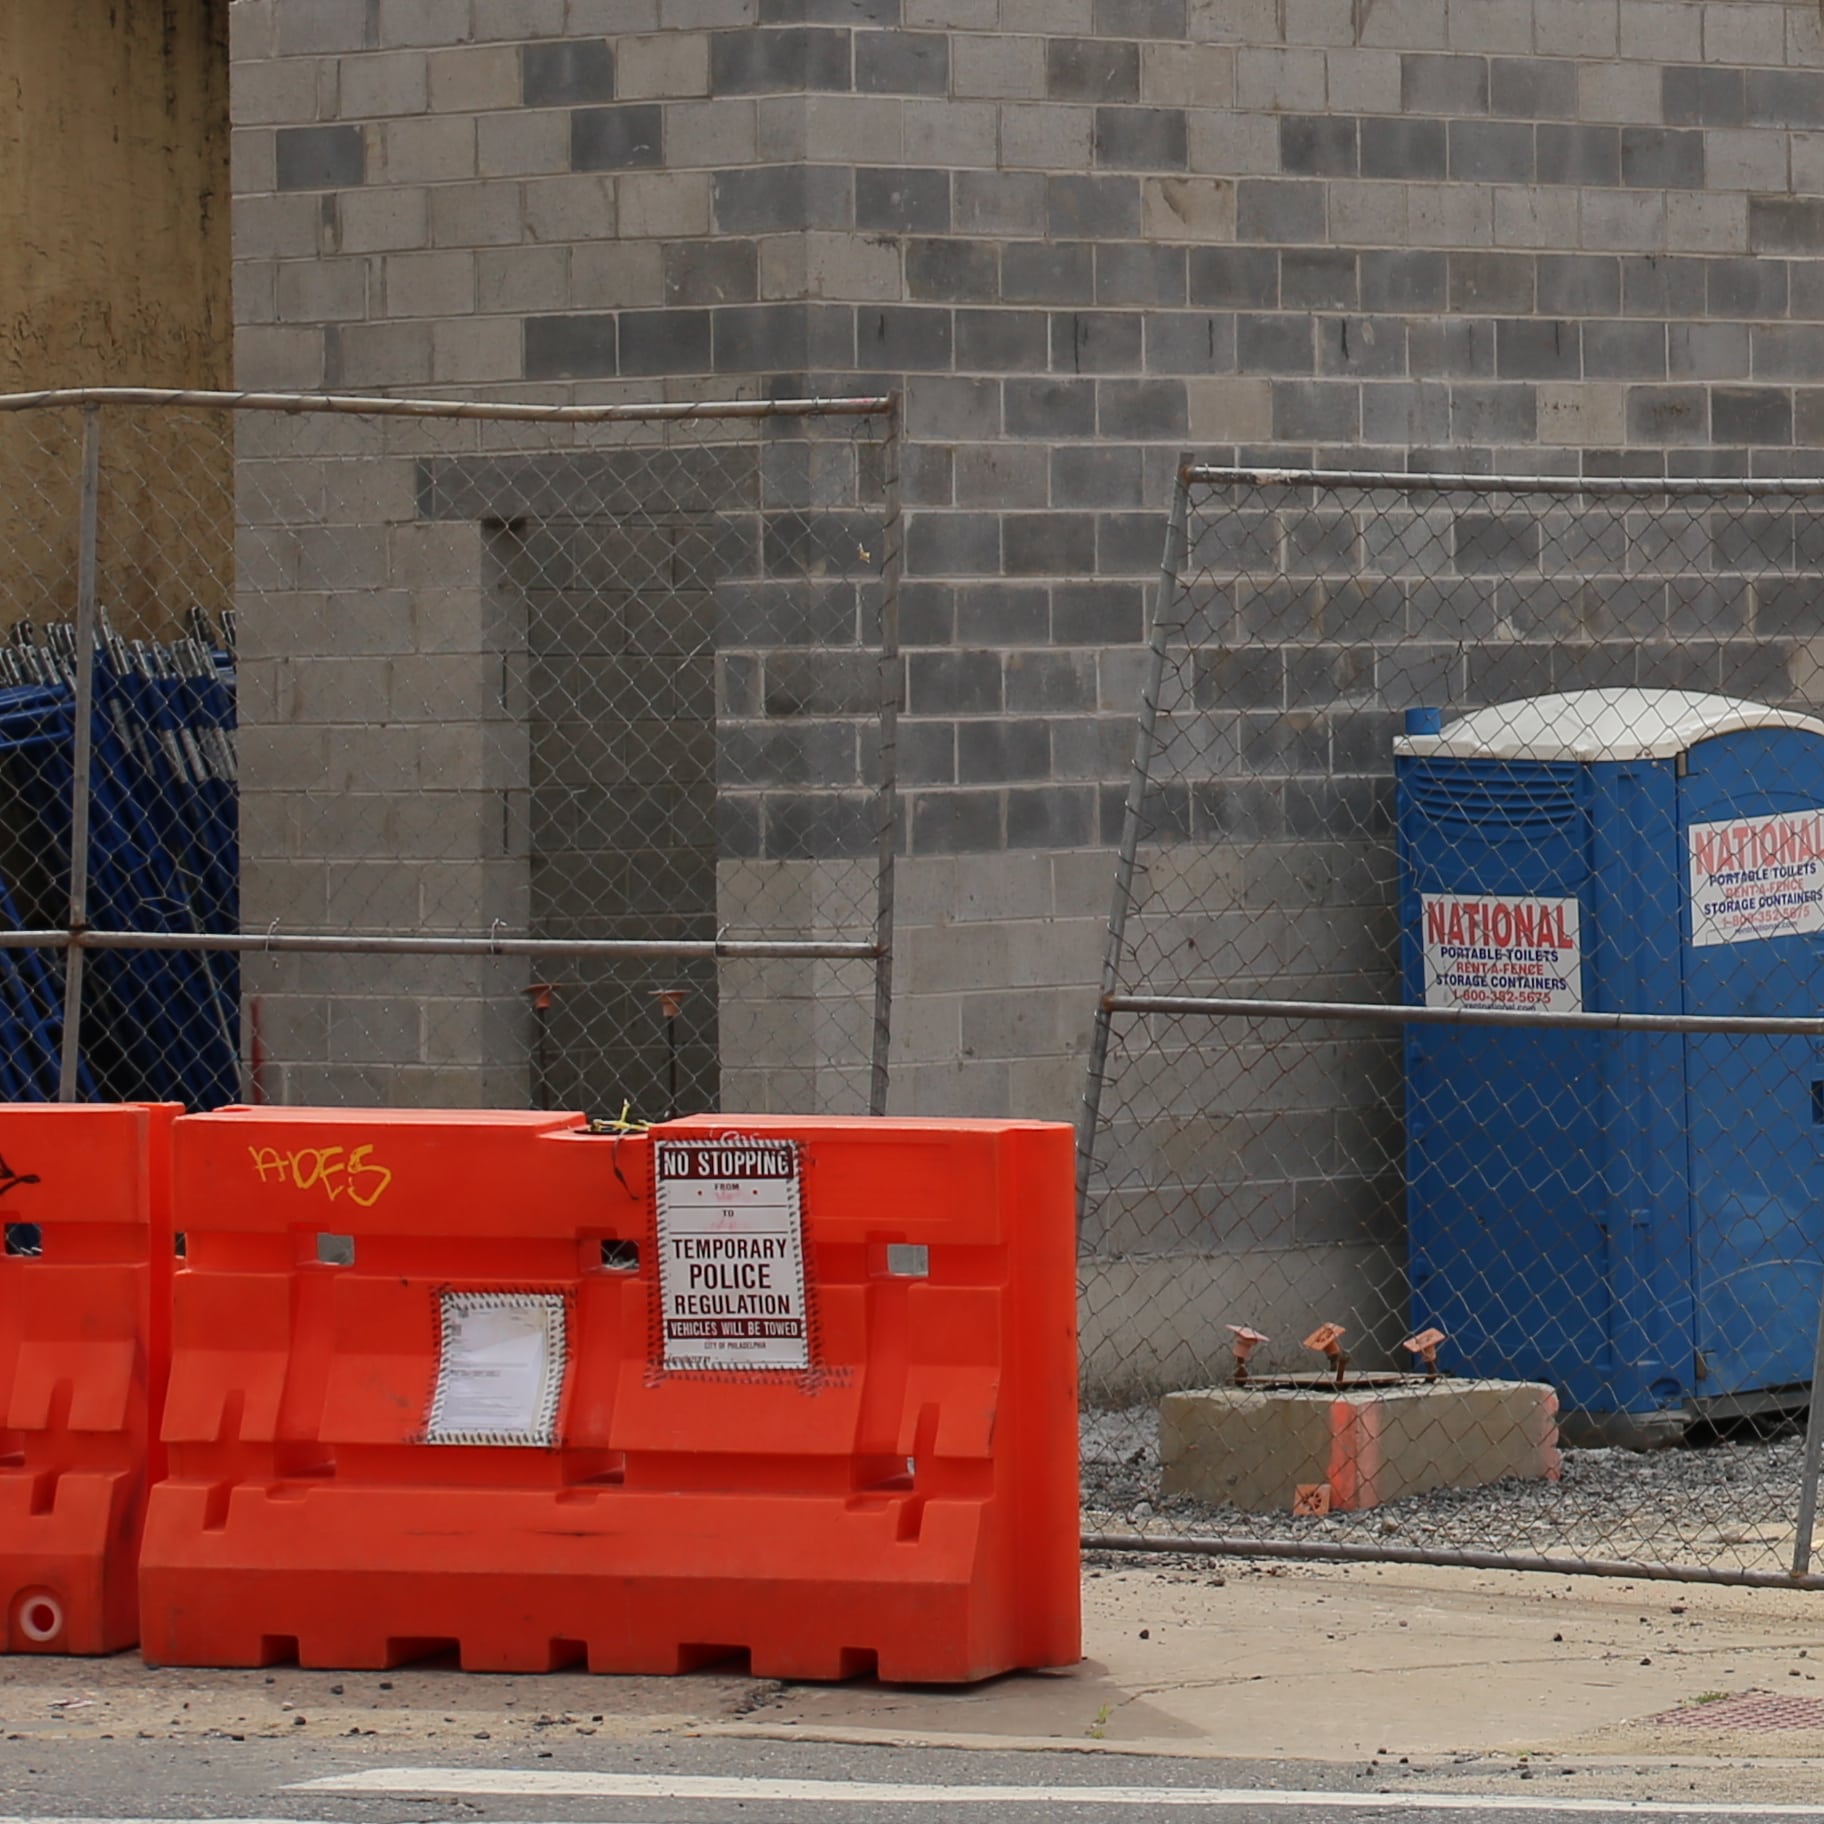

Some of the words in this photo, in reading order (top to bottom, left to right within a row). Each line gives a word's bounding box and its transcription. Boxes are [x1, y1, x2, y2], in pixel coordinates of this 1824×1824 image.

[1708, 868, 1769, 887] PORTABLE
[1770, 862, 1817, 879] TOILETS
[1726, 878, 1805, 898] RENT-A-FENCE
[1704, 899, 1756, 916] STORAGE
[1759, 890, 1824, 909] CONTAINERS
[1427, 902, 1573, 949] NATIONAL
[1441, 947, 1501, 960] PORTABLE
[1506, 949, 1558, 962] TOILETS
[1456, 962, 1544, 975] RENT-A-FENCE
[1436, 974, 1487, 987] STORAGE
[1491, 976, 1567, 990] CONTAINERS
[664, 1151, 689, 1176] NO
[698, 1150, 789, 1176] STOPPING
[714, 1183, 740, 1191] FROM
[723, 1209, 734, 1217] TO
[672, 1238, 787, 1259] TEMPORARY
[690, 1263, 771, 1289] POLICE
[674, 1294, 791, 1315] REGULATION
[670, 1321, 717, 1336] VEHICLES
[720, 1321, 744, 1336] WILL
[747, 1321, 760, 1336] BE
[763, 1321, 798, 1336] TOWED
[727, 1341, 766, 1349] PHILADELPHIA
